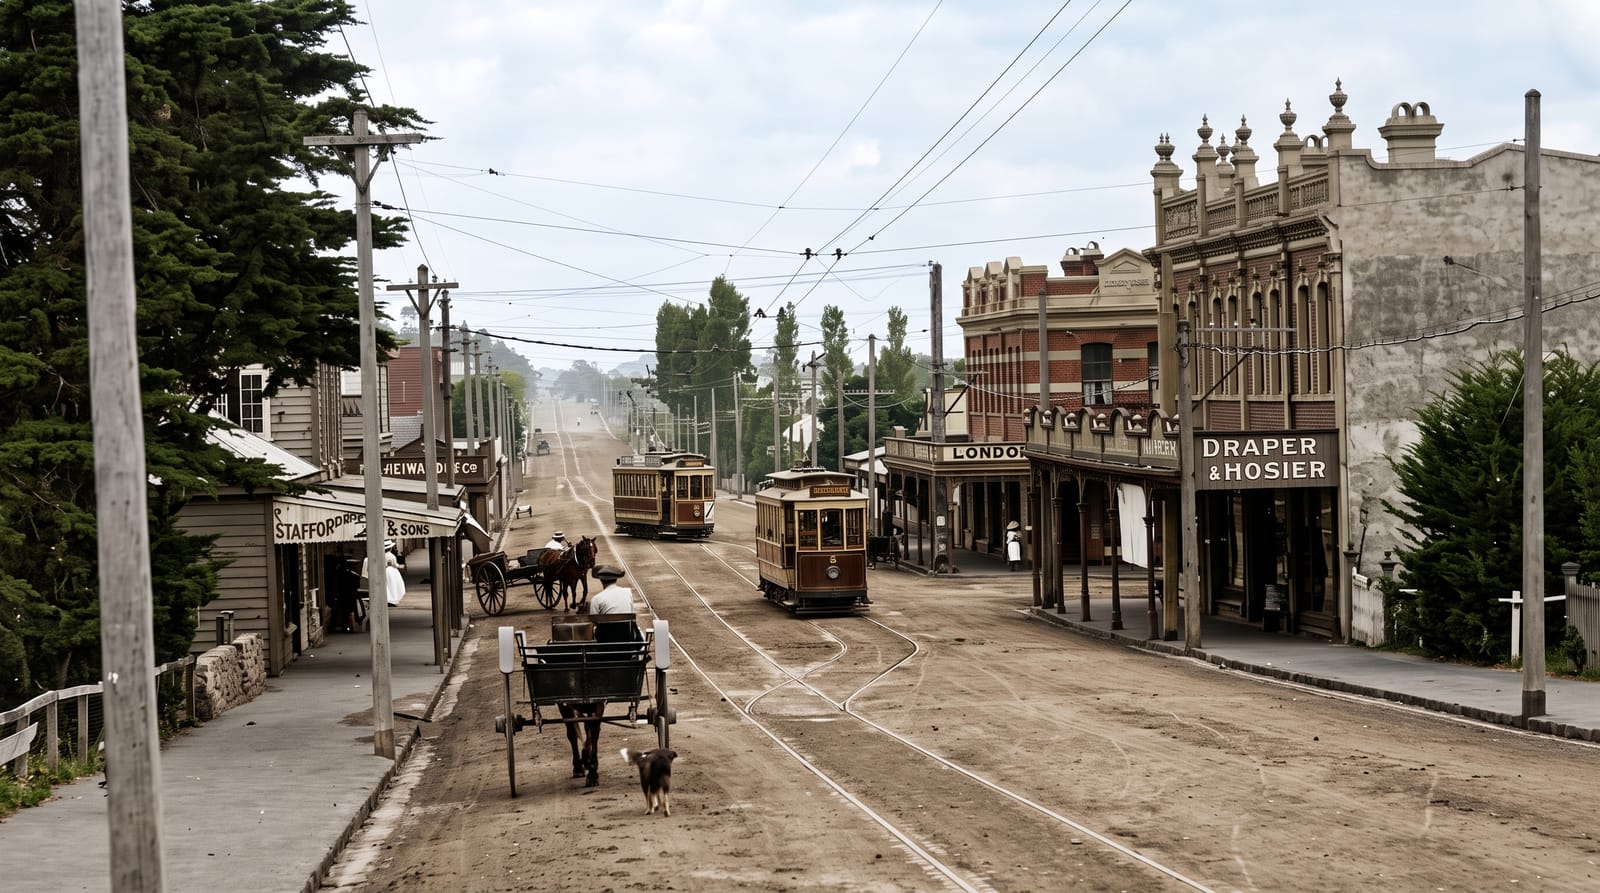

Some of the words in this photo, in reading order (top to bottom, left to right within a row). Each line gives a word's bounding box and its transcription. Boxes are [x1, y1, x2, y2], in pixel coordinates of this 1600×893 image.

[1202, 438, 1317, 458] DRAPER
[387, 520, 398, 537] &
[400, 523, 430, 536] SONS
